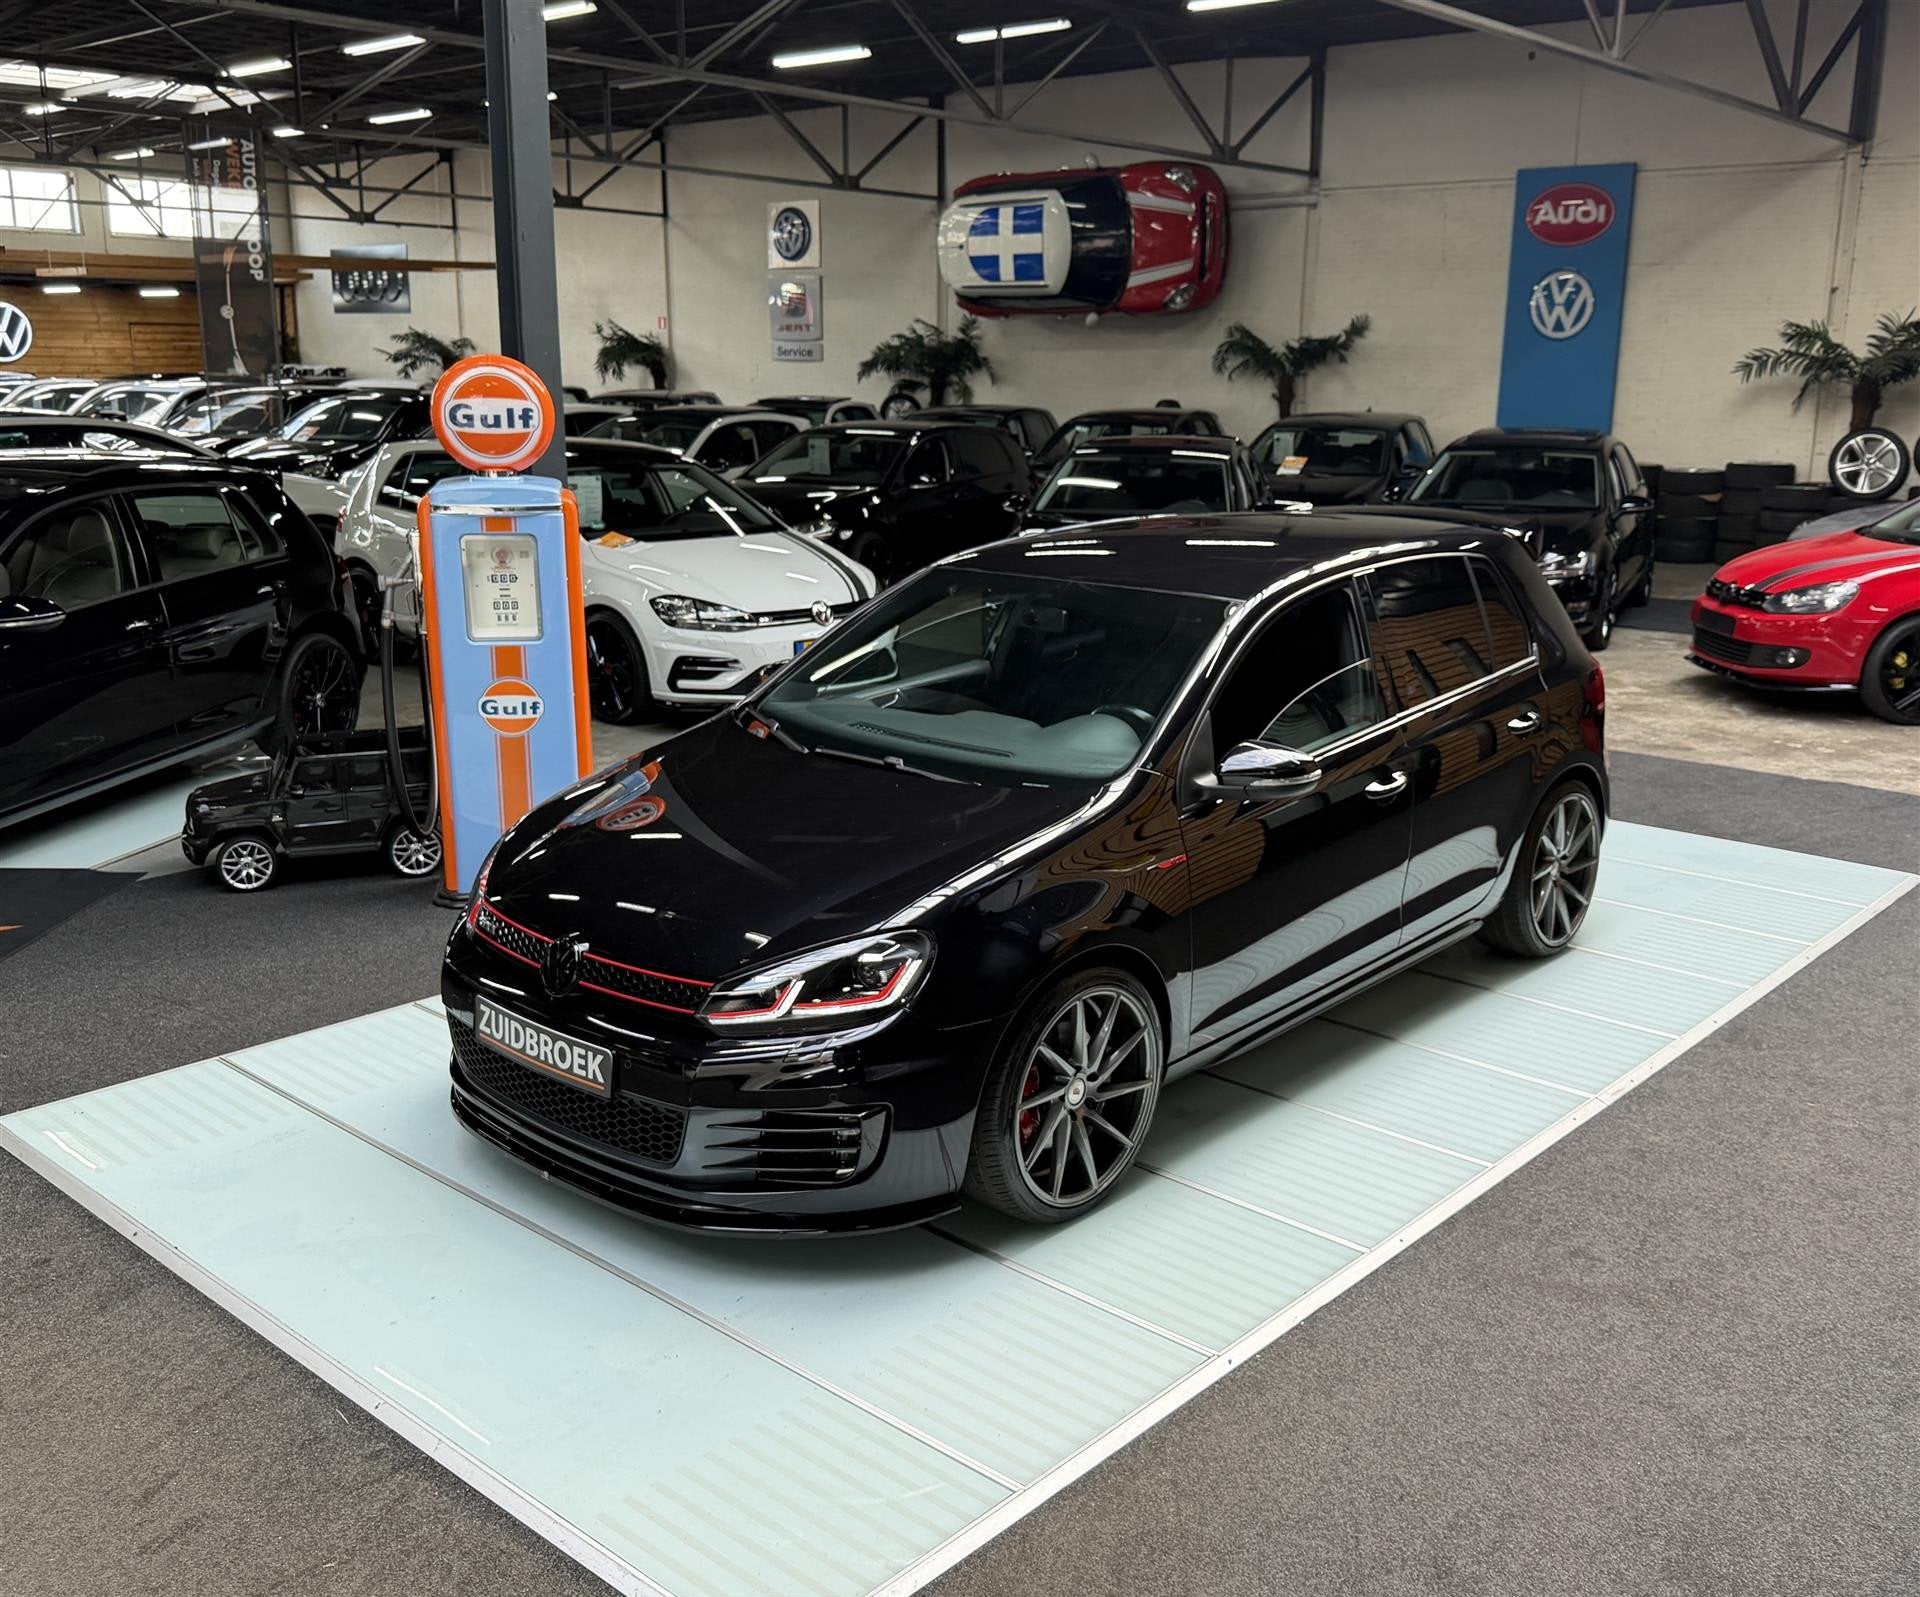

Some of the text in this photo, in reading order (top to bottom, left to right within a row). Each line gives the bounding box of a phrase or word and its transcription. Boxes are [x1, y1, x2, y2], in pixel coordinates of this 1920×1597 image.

[240, 138, 257, 190] AUTO
[777, 346, 813, 358] Service
[449, 403, 534, 429] Gulf
[481, 699, 540, 715] Gulf
[479, 1003, 605, 1083] ZUIDBROEK
